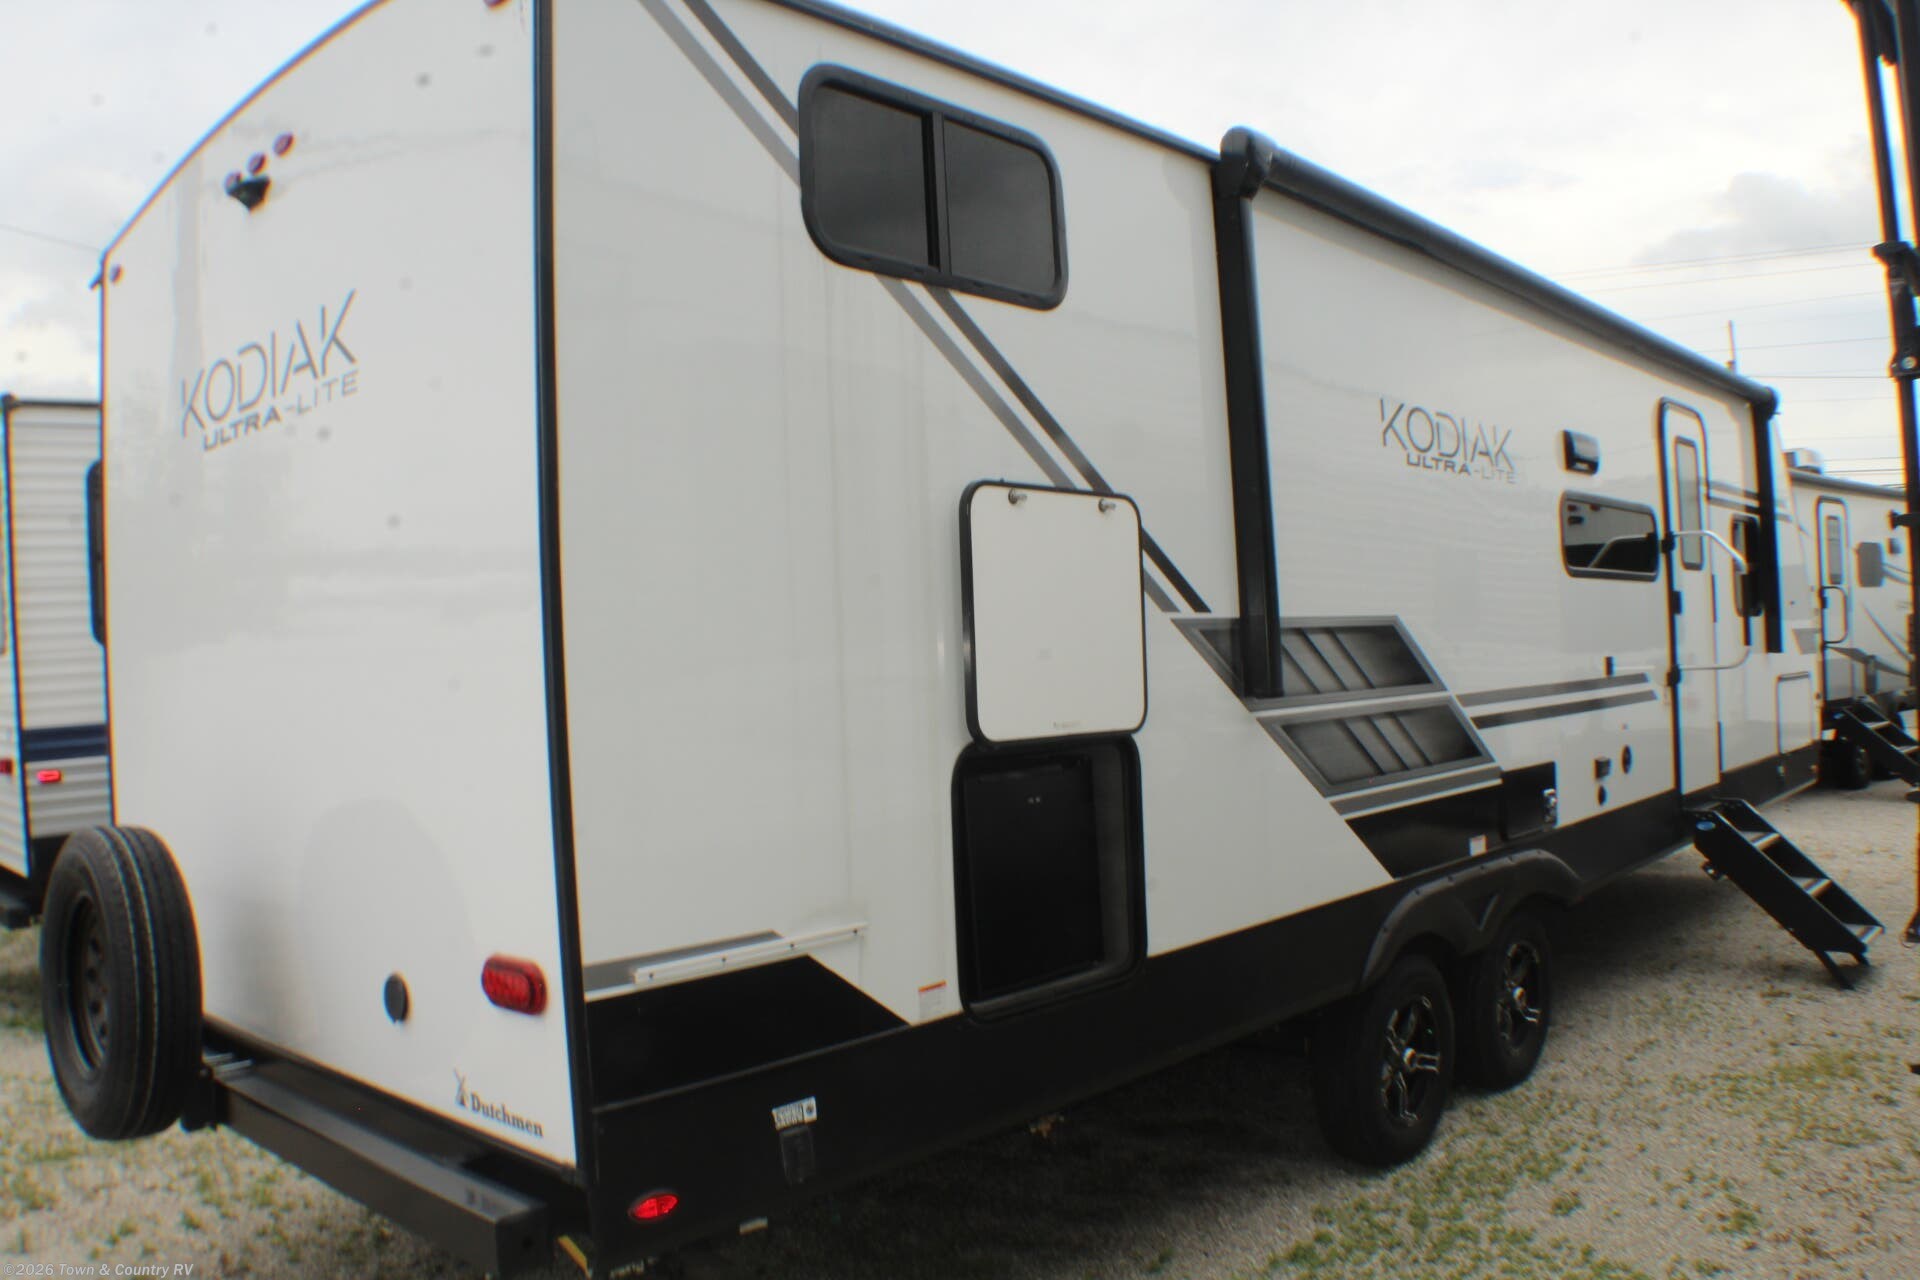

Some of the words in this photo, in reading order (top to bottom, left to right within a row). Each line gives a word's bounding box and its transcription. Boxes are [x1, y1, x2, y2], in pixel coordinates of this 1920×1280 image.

[181, 288, 357, 439] KODIAK
[203, 370, 358, 452] ULTRA-LITE
[1379, 397, 1514, 471] KODIAK
[1406, 452, 1517, 484] ULTRA-LITE
[470, 1091, 544, 1138] Dutchmen
